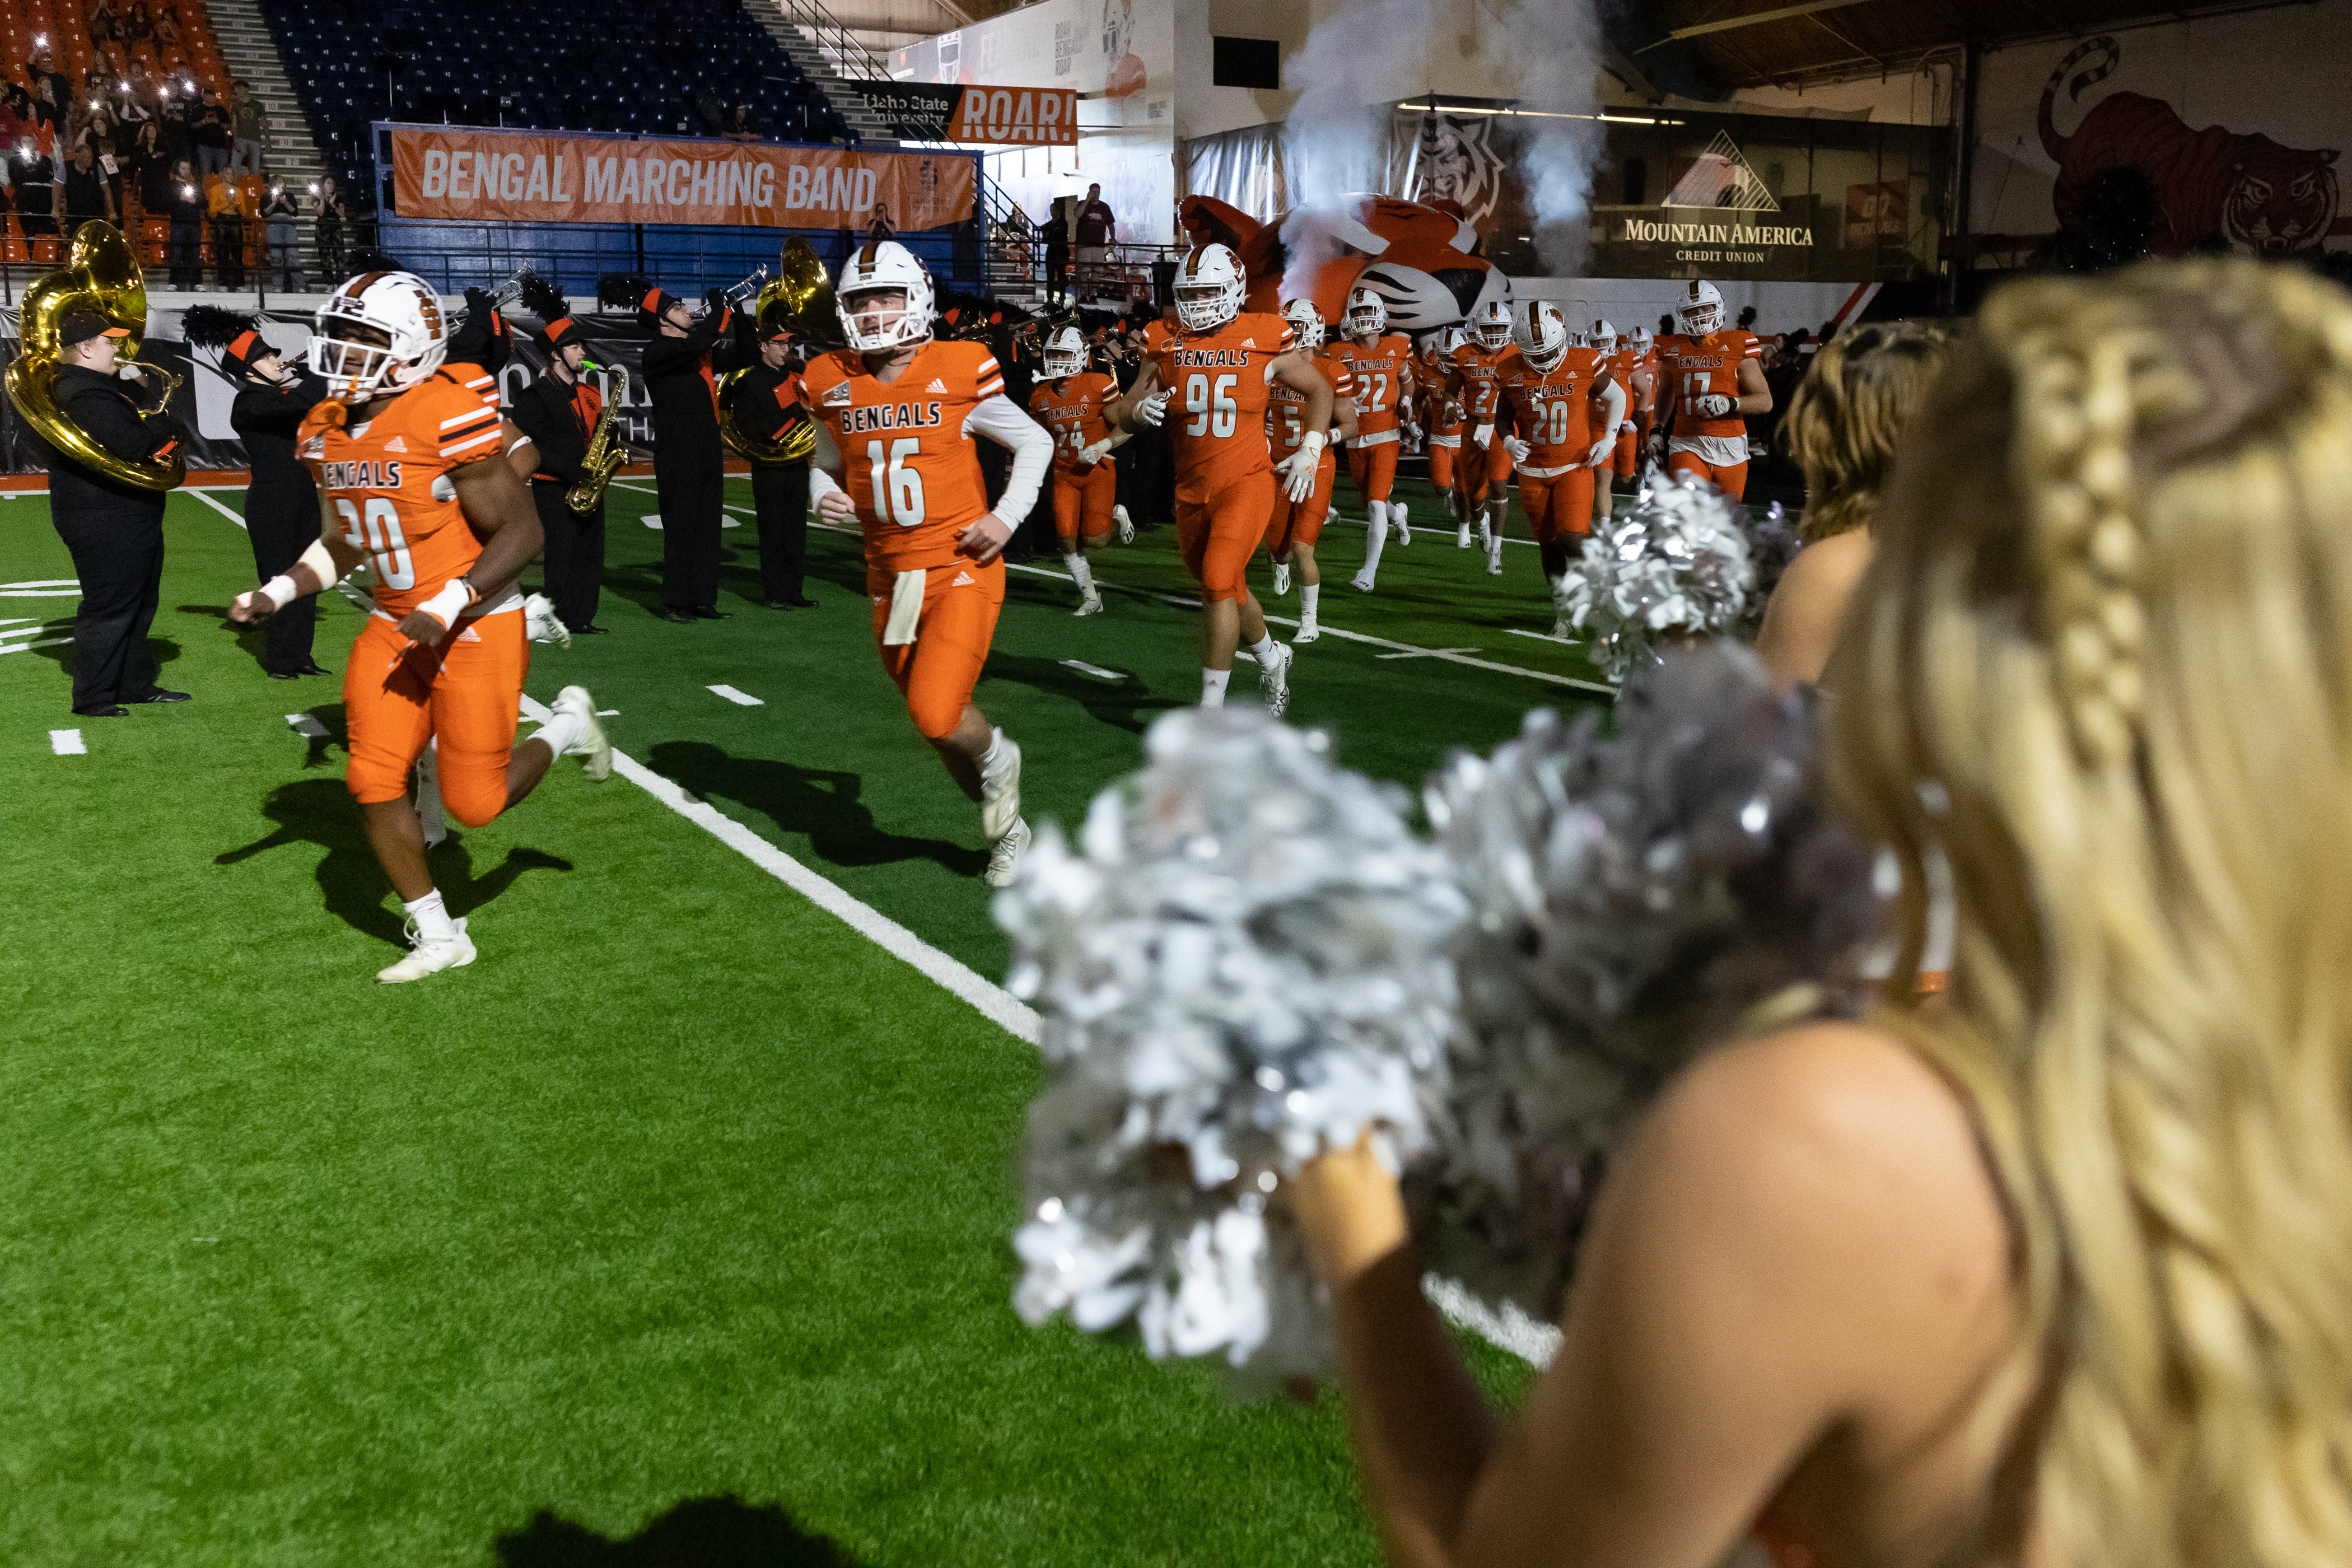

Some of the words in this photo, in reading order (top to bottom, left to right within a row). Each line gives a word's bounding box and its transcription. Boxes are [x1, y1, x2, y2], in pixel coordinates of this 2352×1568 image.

[911, 95, 949, 111] State
[962, 88, 1075, 141] ROAR!
[422, 150, 570, 202] BENGAL
[584, 157, 774, 208] MARCHING
[785, 164, 876, 212] BAND
[1625, 218, 1728, 244] MOUNTAIN
[1731, 224, 1814, 246] AMERICA
[1676, 250, 1722, 262] CREDIT
[1725, 251, 1764, 263] UNION
[1174, 349, 1249, 367] BENGALS
[1347, 359, 1393, 372] BENGALS
[1673, 356, 1724, 369] BENGALS
[1186, 374, 1238, 438] 96
[1357, 373, 1388, 413] 22
[1520, 382, 1574, 400] BENGALS
[1683, 372, 1711, 416] 17
[840, 402, 942, 435] BENGALS
[1046, 403, 1088, 422] BENGALS
[1284, 405, 1301, 447] 5
[1532, 400, 1568, 445] 20
[1053, 421, 1086, 458] 24
[320, 460, 403, 490] ENGALS
[867, 437, 926, 527] 16
